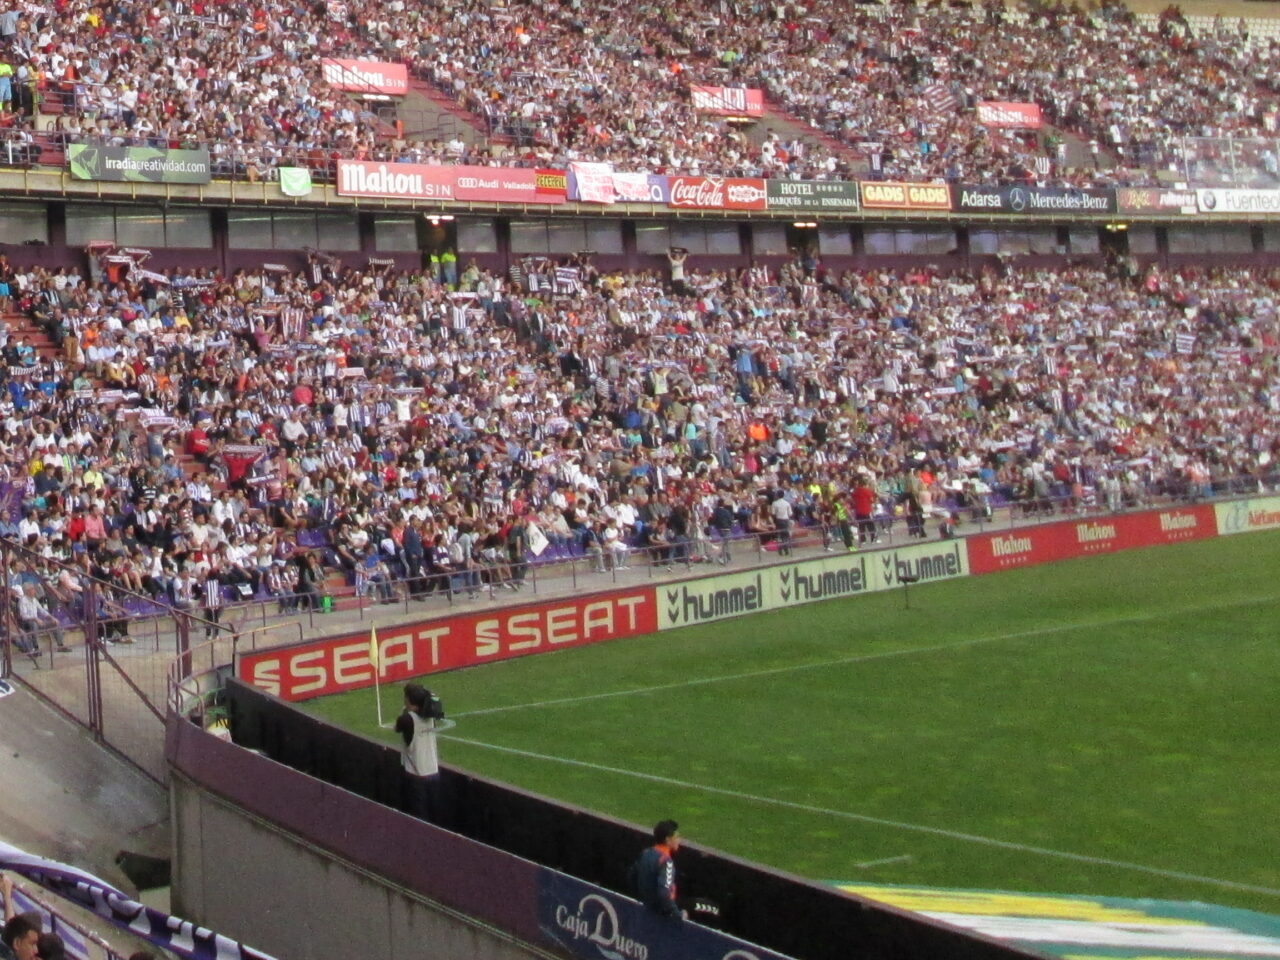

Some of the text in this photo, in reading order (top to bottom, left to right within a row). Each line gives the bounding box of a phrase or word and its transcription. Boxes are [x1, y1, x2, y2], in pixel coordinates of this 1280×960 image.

[324, 64, 406, 88] Mahou SIN
[105, 155, 206, 173] irradiacreatividad.com
[341, 163, 452, 196] Mahou SIN
[478, 178, 499, 189] Audi
[781, 182, 815, 196] HOTEL
[821, 196, 857, 207] ENSENADA
[865, 186, 948, 203] GADIS GADIS
[960, 189, 1002, 207] Adarsa
[1029, 192, 1109, 210] Mercedes-Benz
[1159, 511, 1197, 531] Mahou
[1076, 522, 1116, 543] Mahou
[990, 534, 1032, 557] Mahou
[893, 542, 962, 585] hummel
[793, 557, 867, 601] hummel
[682, 573, 762, 622] hummel
[508, 595, 646, 652] SEAT
[289, 626, 451, 694] SEAT
[555, 893, 649, 960] Caja Duero
